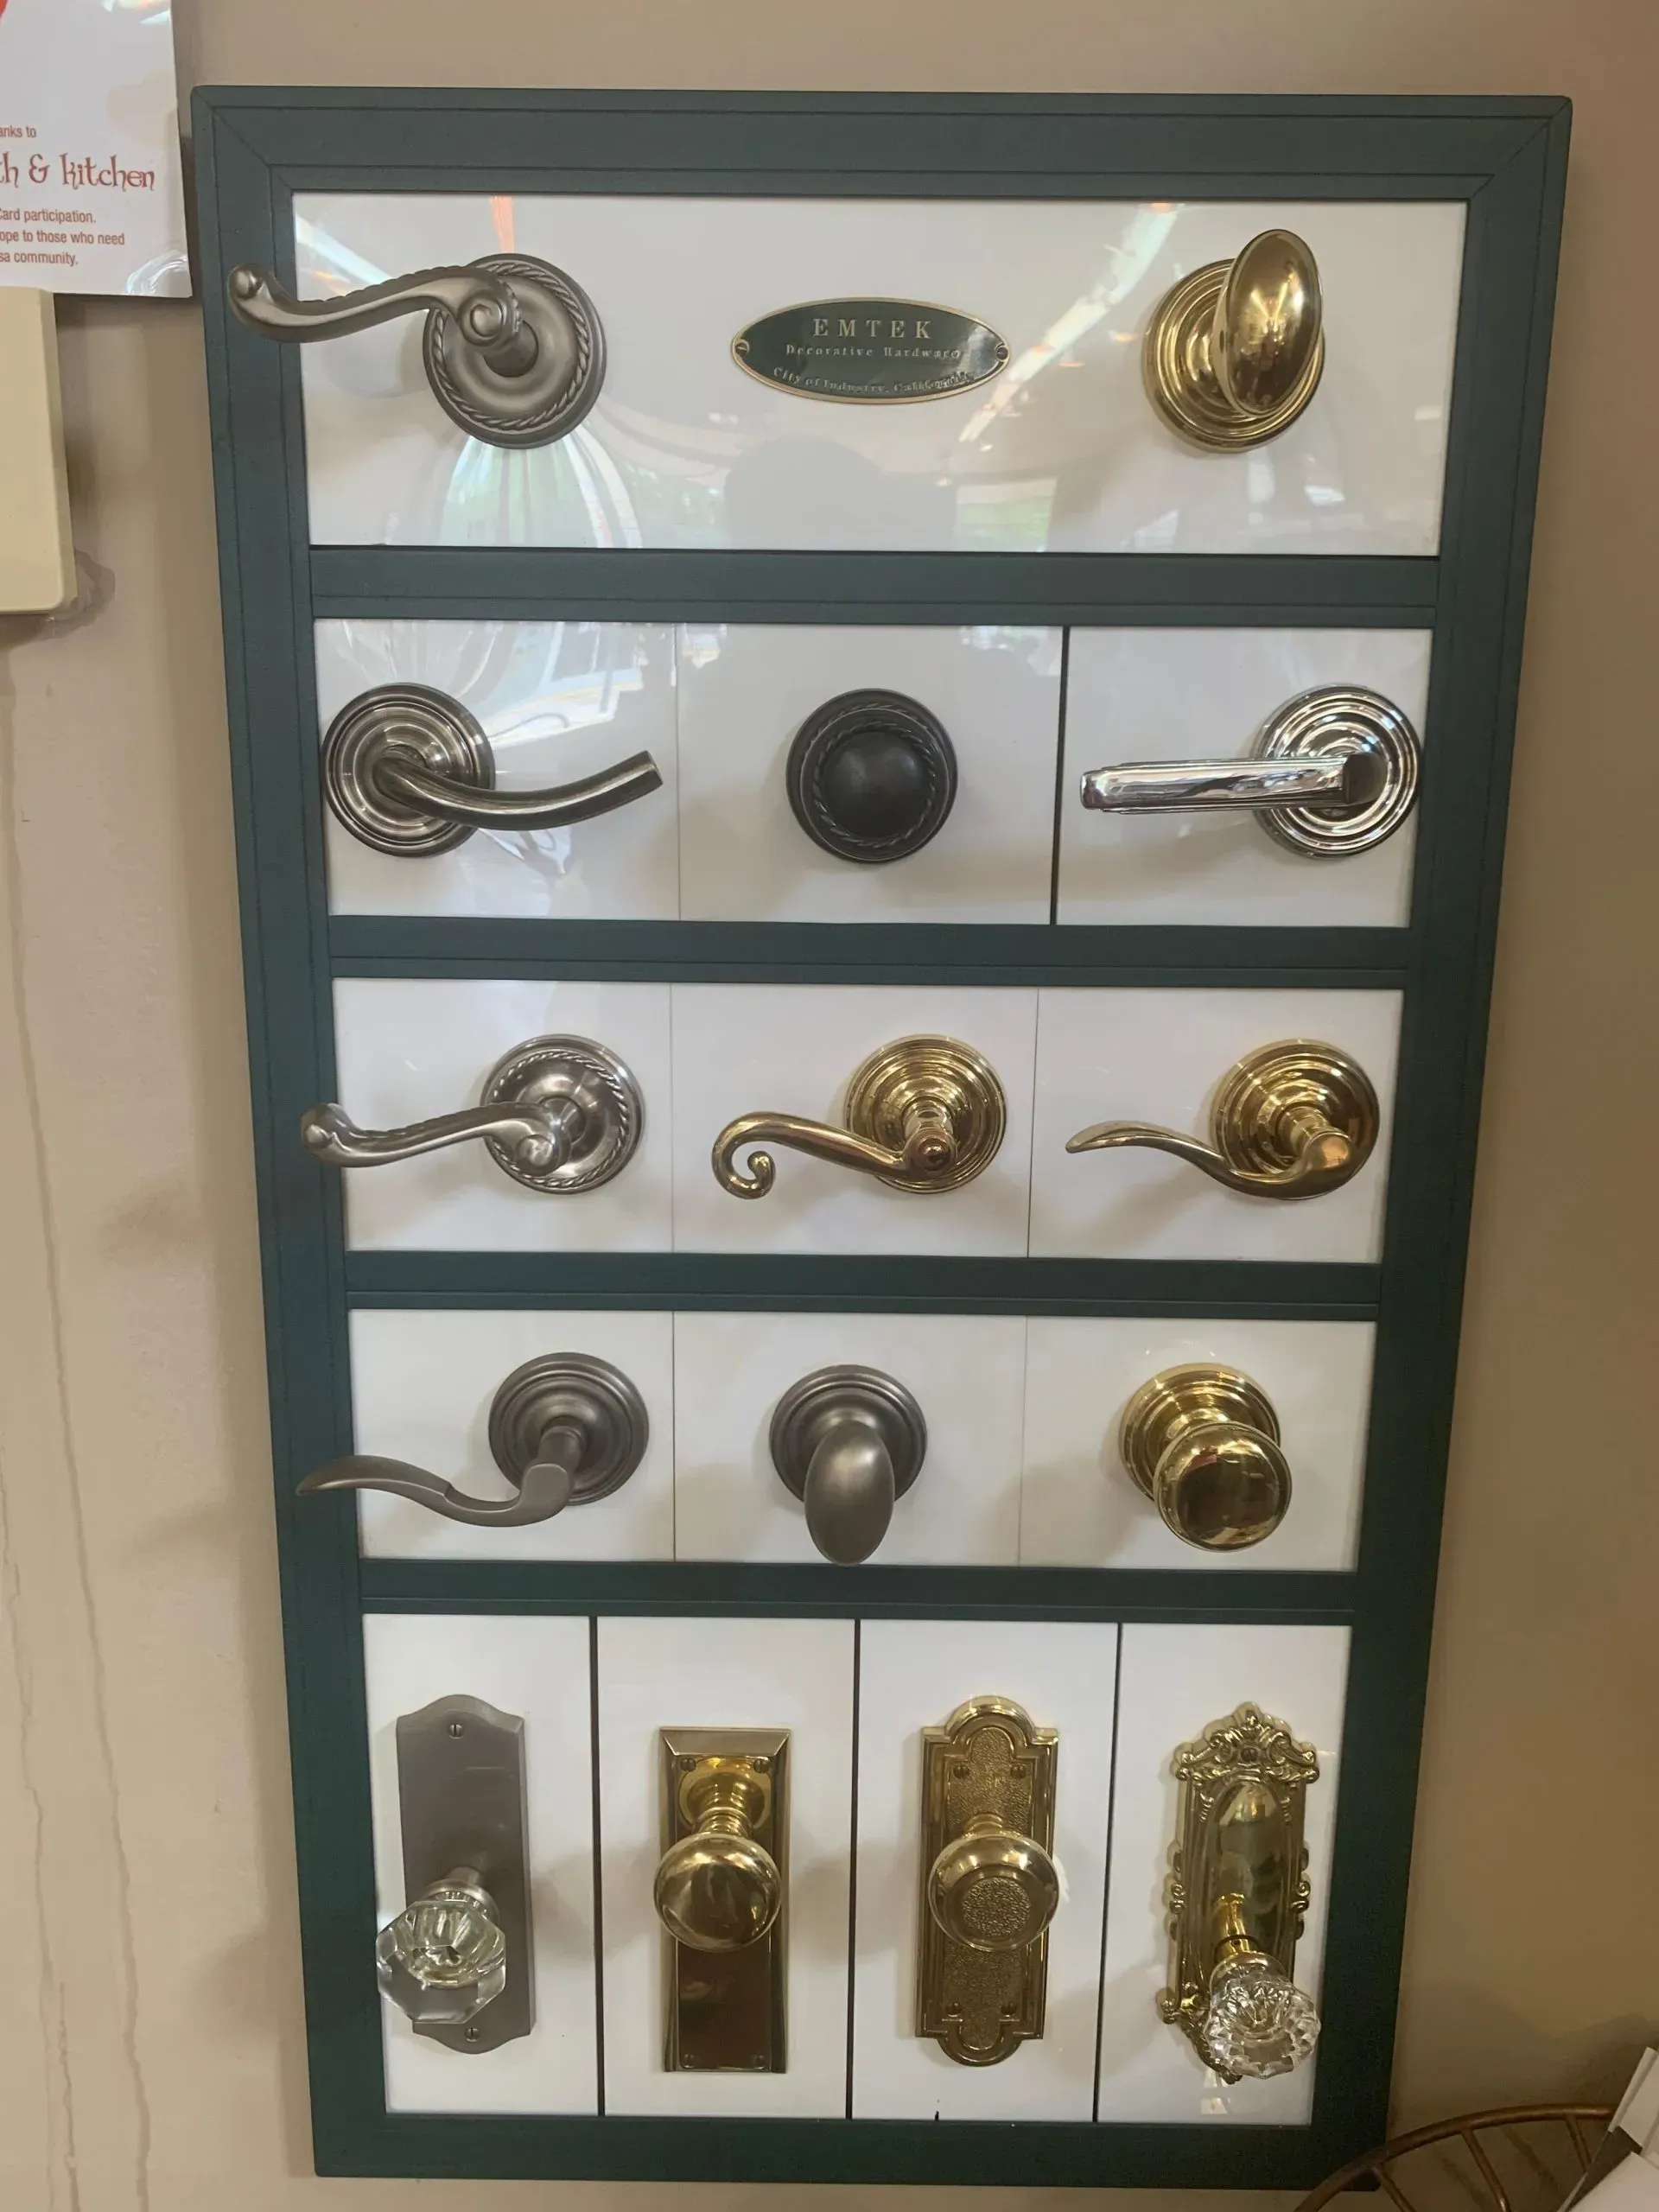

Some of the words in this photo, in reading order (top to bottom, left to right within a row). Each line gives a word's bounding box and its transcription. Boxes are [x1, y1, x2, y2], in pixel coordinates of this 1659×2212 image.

[26, 126, 37, 138] to
[29, 153, 50, 184] &
[60, 152, 156, 192] kitchen
[23, 209, 97, 225] participation.
[22, 230, 34, 243] to
[36, 230, 67, 244] those
[70, 231, 94, 245] who
[98, 232, 125, 246] need
[14, 251, 79, 267] community.
[812, 318, 933, 340] EMTEK
[785, 344, 874, 357] Decorative
[883, 346, 962, 359] Hardware
[772, 365, 802, 385] City
[804, 378, 822, 387] of
